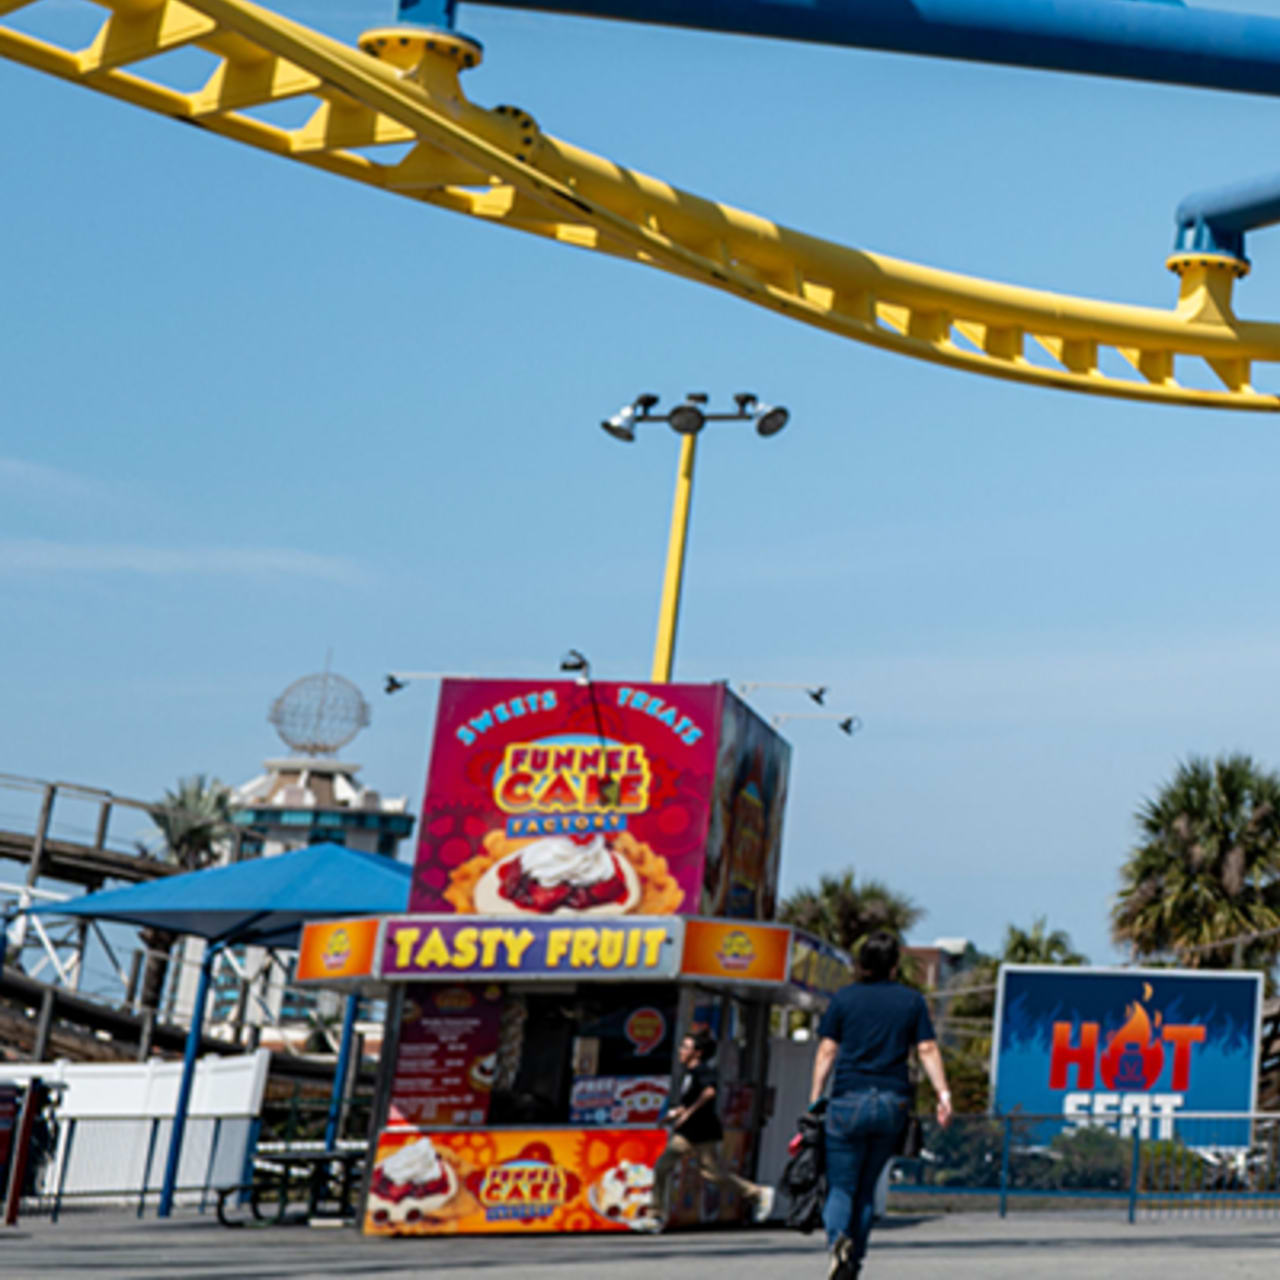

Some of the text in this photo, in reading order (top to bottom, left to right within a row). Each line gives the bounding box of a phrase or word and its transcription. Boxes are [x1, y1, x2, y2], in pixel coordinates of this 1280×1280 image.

[456, 687, 703, 745] SWEETS TREATS
[510, 749, 642, 772] FUNNEL
[501, 772, 644, 806] CAKE
[512, 817, 620, 833] FACTORY
[395, 926, 534, 968] TASTY
[546, 927, 666, 968] FRUIT
[1049, 1001, 1206, 1091] HOT
[1062, 1093, 1183, 1140] SEAT
